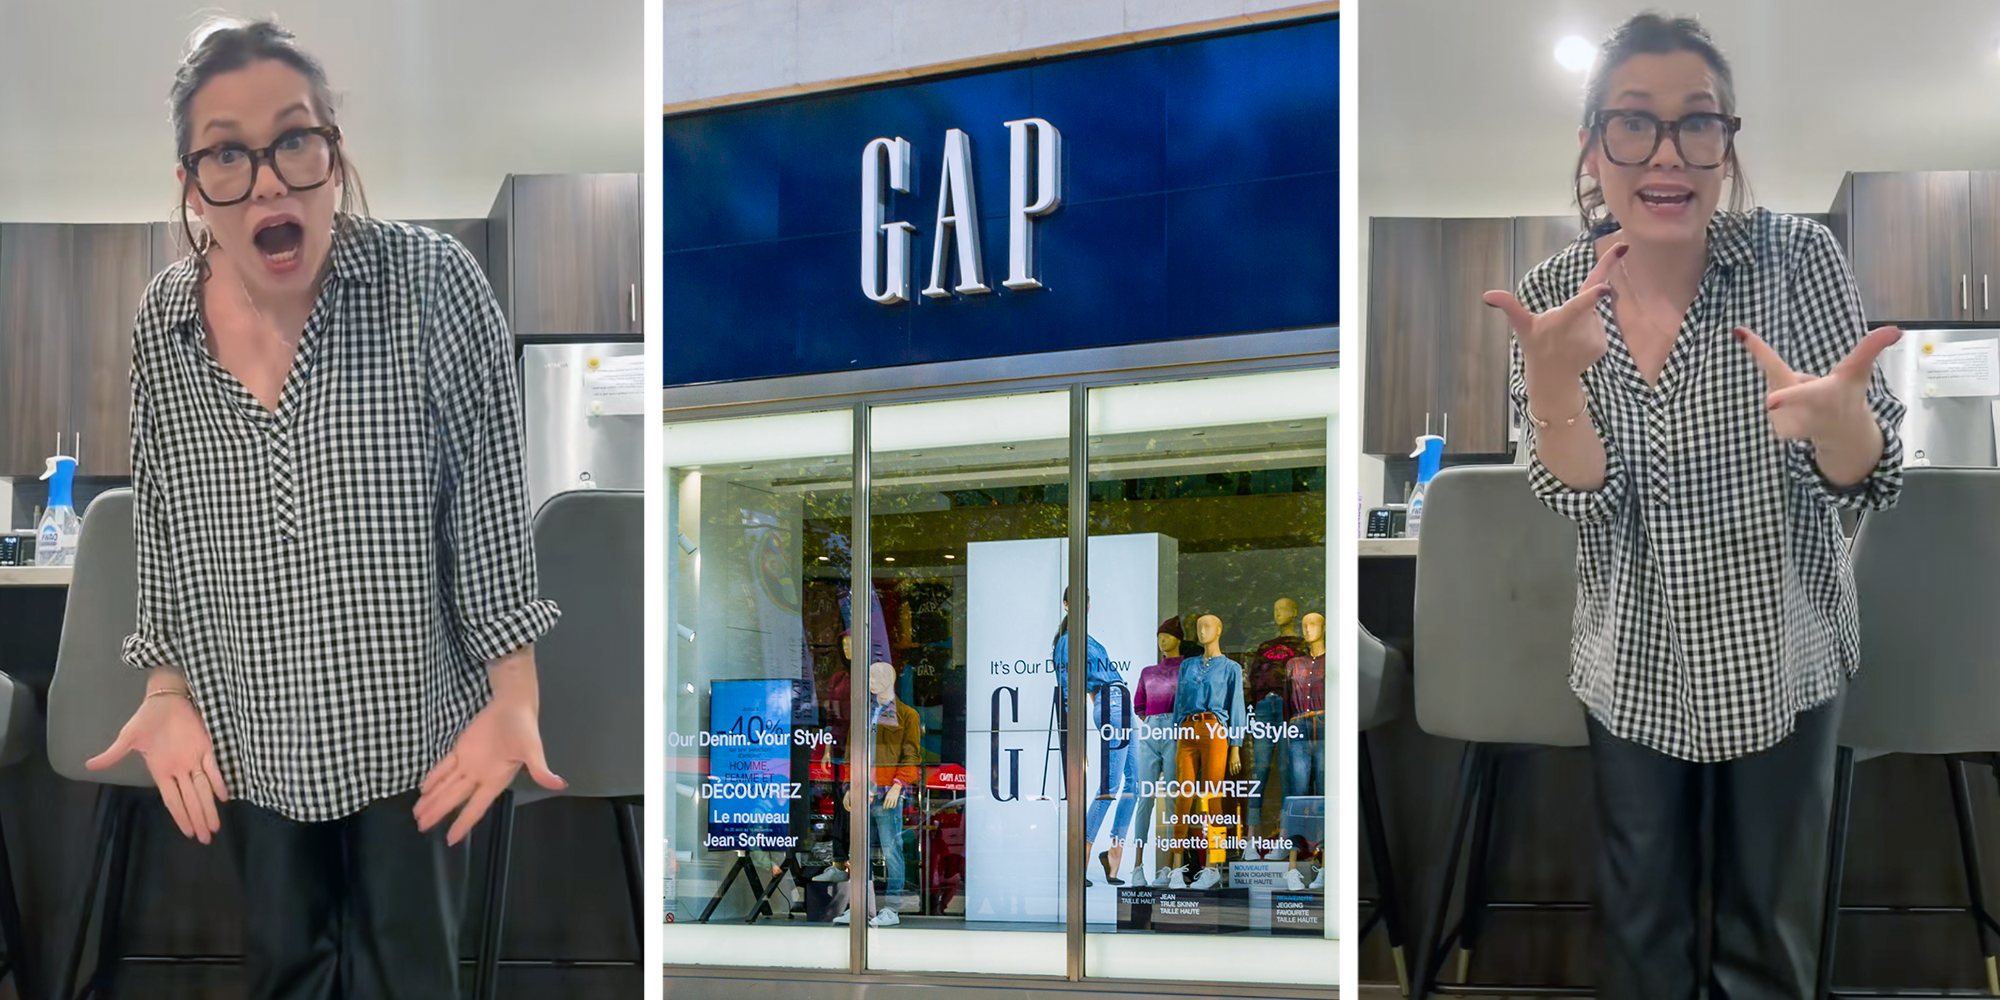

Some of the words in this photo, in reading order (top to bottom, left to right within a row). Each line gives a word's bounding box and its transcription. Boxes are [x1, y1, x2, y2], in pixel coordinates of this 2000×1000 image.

[861, 117, 1062, 305] GAP
[917, 664, 935, 677] GAP
[991, 660, 1010, 674] It's
[1014, 660, 1041, 674] Our
[1046, 659, 1092, 673] Dem
[1097, 658, 1131, 671] Now
[717, 715, 783, 744] -40%
[1100, 724, 1131, 741] Our
[1138, 723, 1200, 740] Denim.
[1205, 723, 1246, 740] Your
[1253, 721, 1304, 743] Style.
[668, 731, 695, 748] Our
[699, 731, 751, 746] Denim.
[755, 730, 790, 746] Your
[794, 729, 837, 749] Style.
[991, 684, 1131, 802] GAP
[729, 761, 770, 771] HOMME,
[724, 773, 760, 782] FEMME
[762, 773, 774, 782] ET
[702, 778, 802, 799] DÉCOUVREZ
[1141, 777, 1261, 798] DÉCOUVREZ
[714, 810, 730, 824] Le
[733, 811, 789, 824] nouveau
[1162, 811, 1178, 825] Le
[1182, 813, 1241, 825] nouveau
[703, 833, 734, 848] Jean
[738, 832, 799, 848] Softwear
[1110, 836, 1143, 849] Jean
[1148, 836, 1208, 851] Cigarette
[1212, 836, 1247, 849] Taille
[1252, 836, 1293, 849] Haute
[1276, 894, 1314, 902] NOUVEAUTÉ
[1297, 916, 1318, 924] HAUTE
